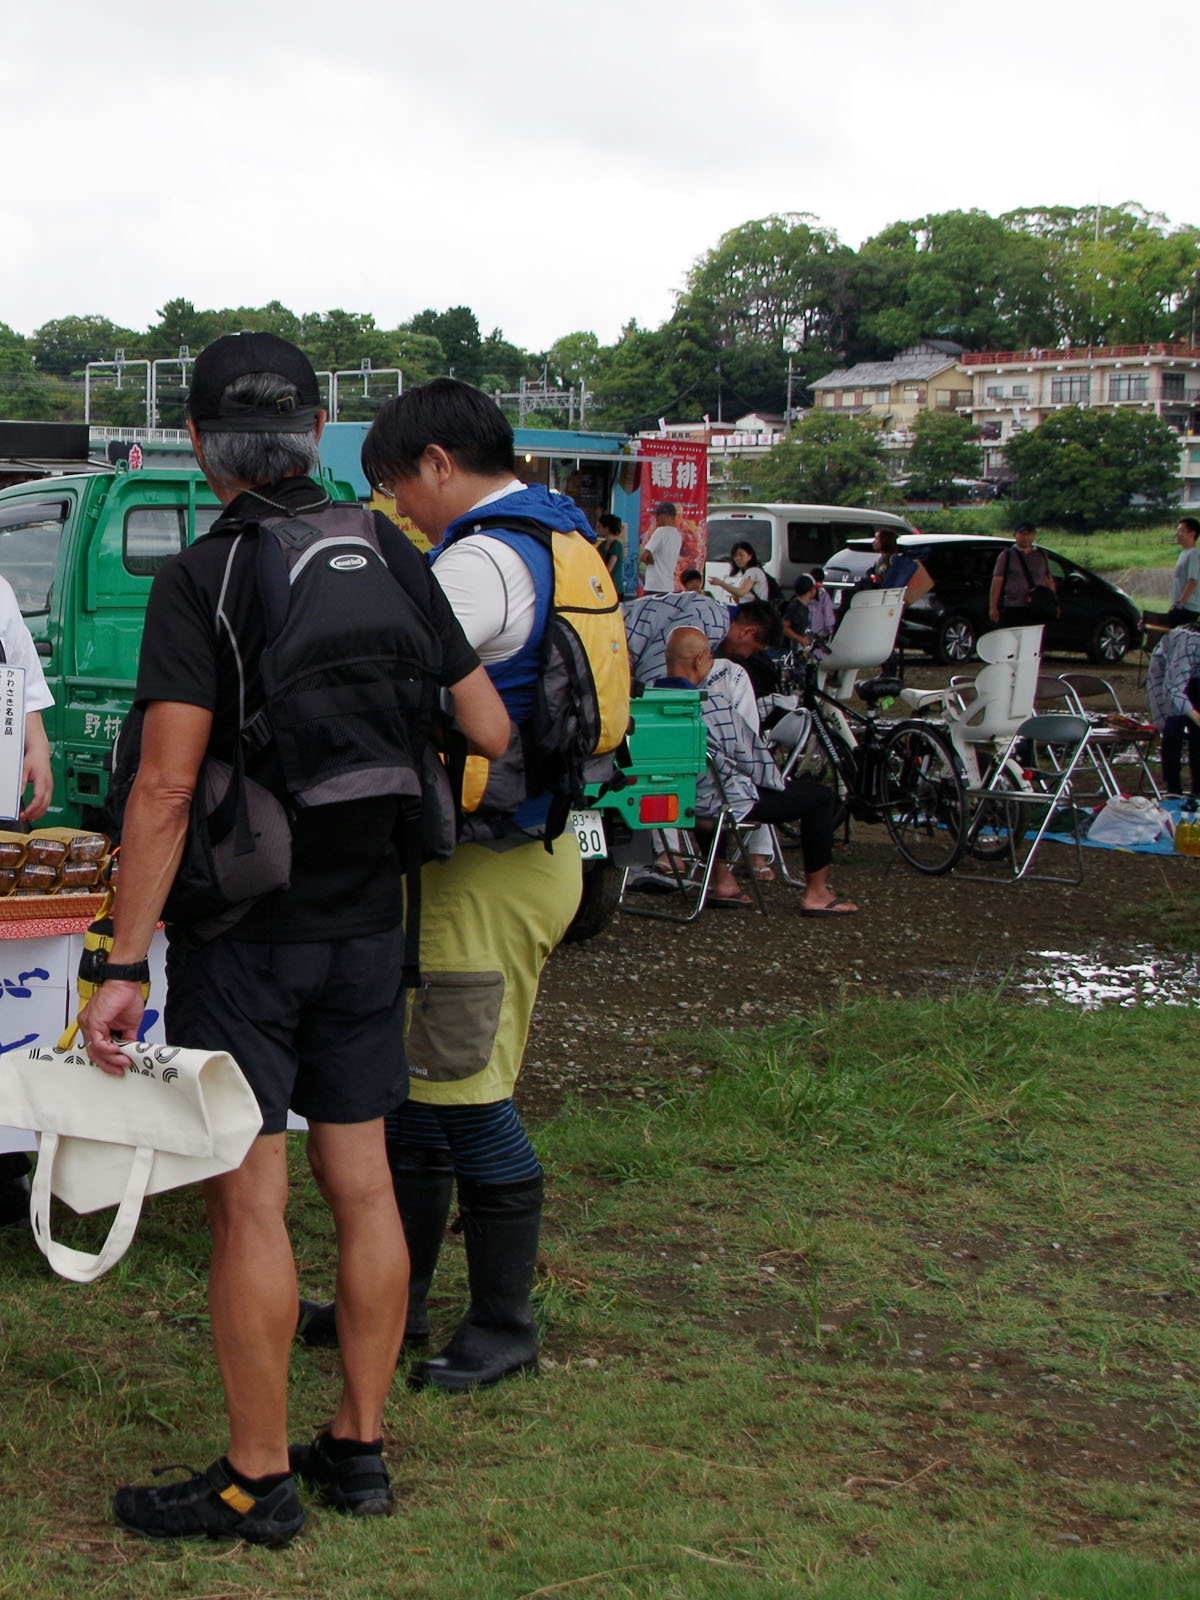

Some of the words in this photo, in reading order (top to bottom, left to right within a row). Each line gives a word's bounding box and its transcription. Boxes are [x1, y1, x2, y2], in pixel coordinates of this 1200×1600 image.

[4, 669, 15, 736] かわさき名産品
[84, 712, 122, 740] 野村
